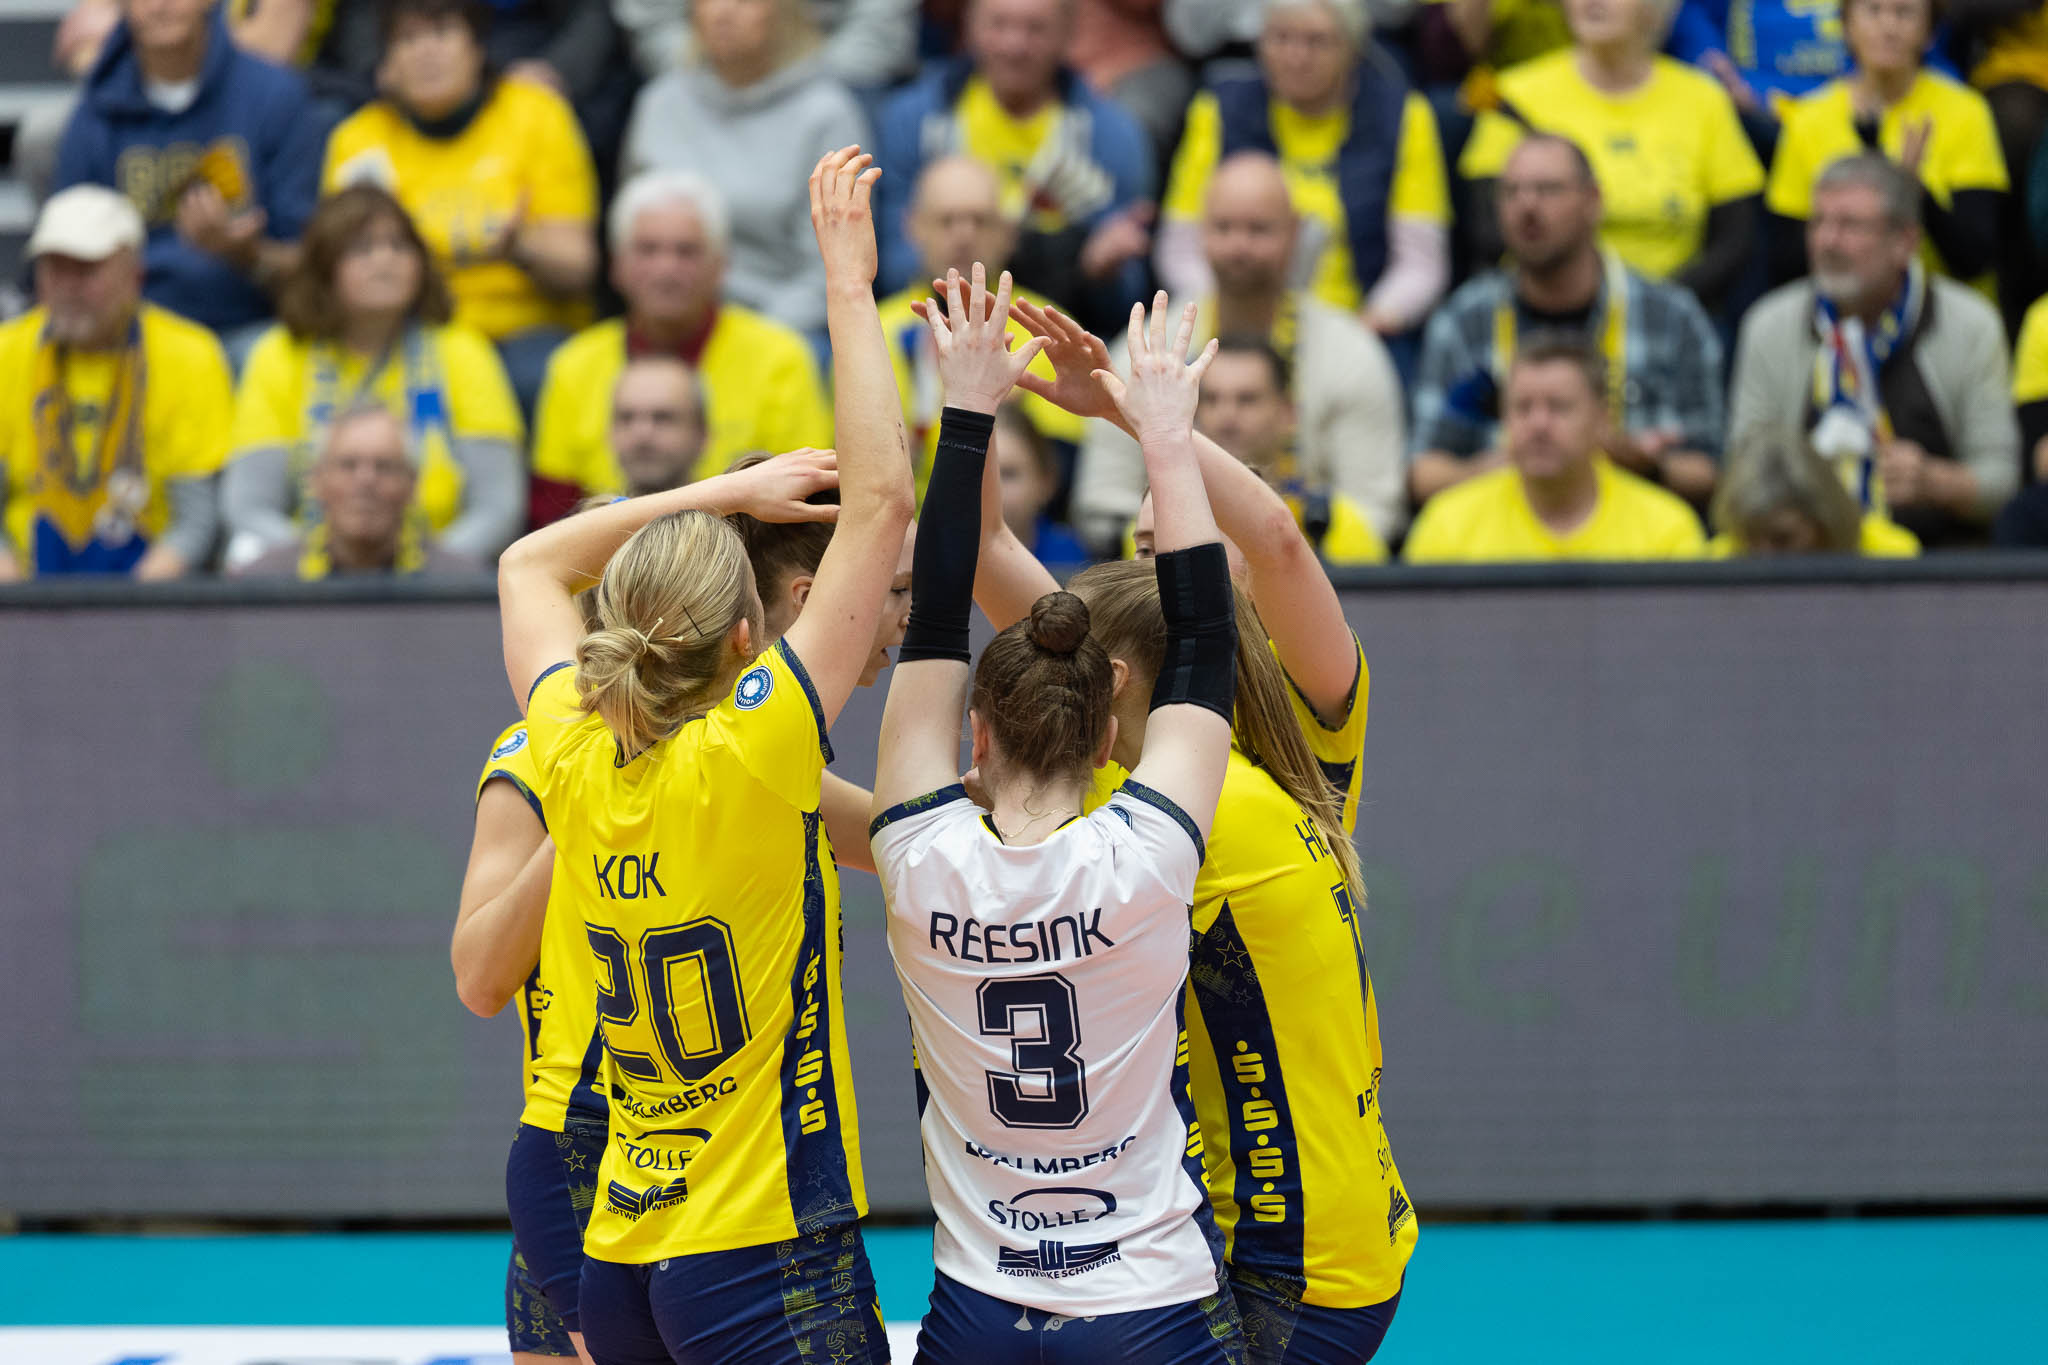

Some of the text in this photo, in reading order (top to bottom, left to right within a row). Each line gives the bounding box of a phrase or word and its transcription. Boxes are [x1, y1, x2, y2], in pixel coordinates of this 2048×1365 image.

[594, 851, 667, 900] KOK
[929, 908, 1116, 964] REESINK
[584, 915, 753, 1087] 20
[975, 971, 1090, 1130] 3
[987, 1199, 1090, 1232] STOLLE
[1061, 1252, 1122, 1278] SCHWERIN
